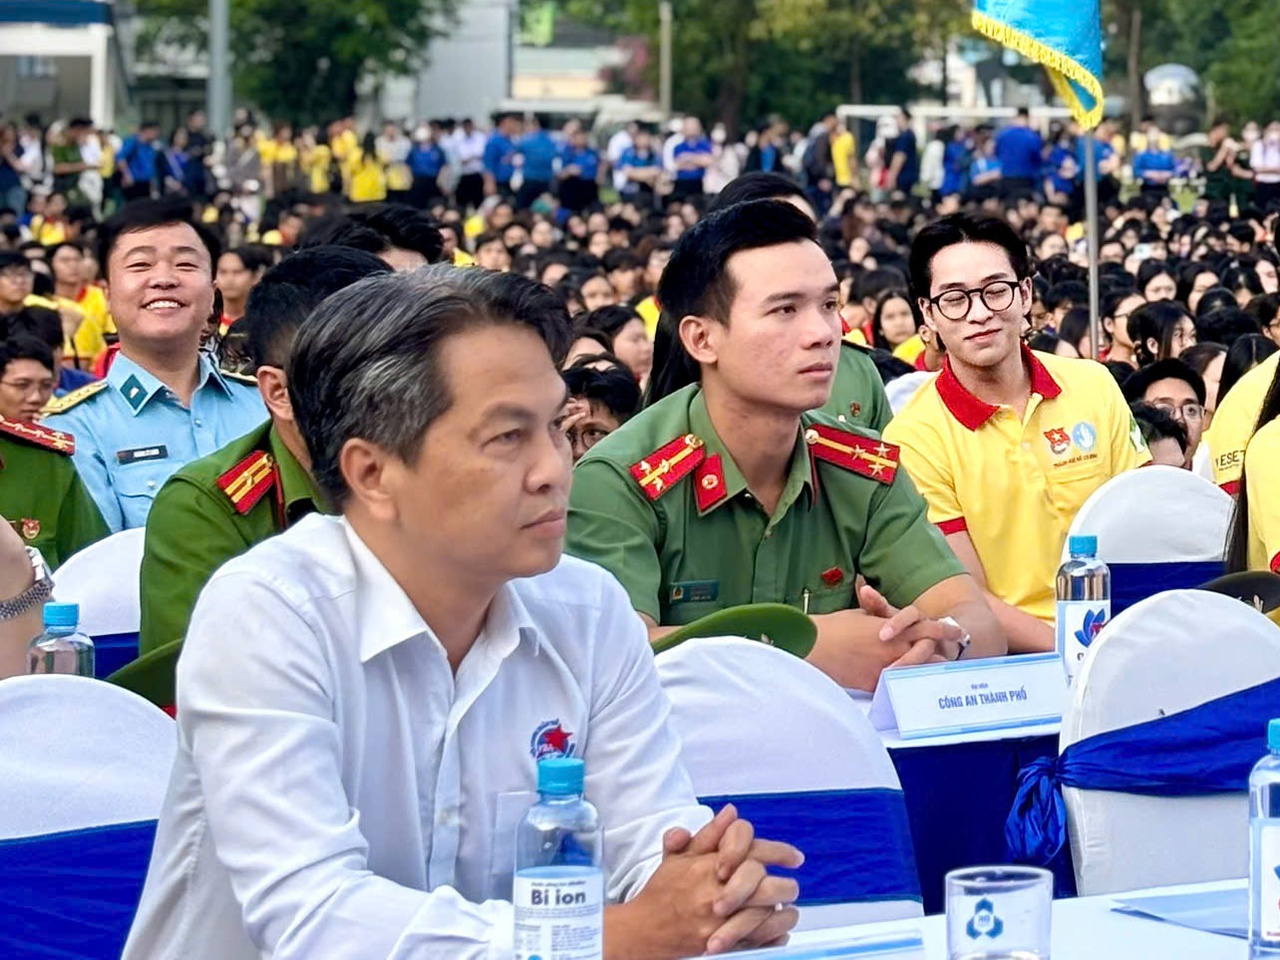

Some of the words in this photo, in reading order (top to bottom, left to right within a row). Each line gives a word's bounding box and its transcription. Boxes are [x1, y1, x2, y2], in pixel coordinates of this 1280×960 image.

[938, 694, 964, 710] CÔNG
[965, 694, 978, 706] AN
[979, 690, 1008, 705] THÀNH
[1009, 685, 1028, 702] PHỐ
[531, 888, 549, 905] Bi
[556, 888, 586, 905] ion
